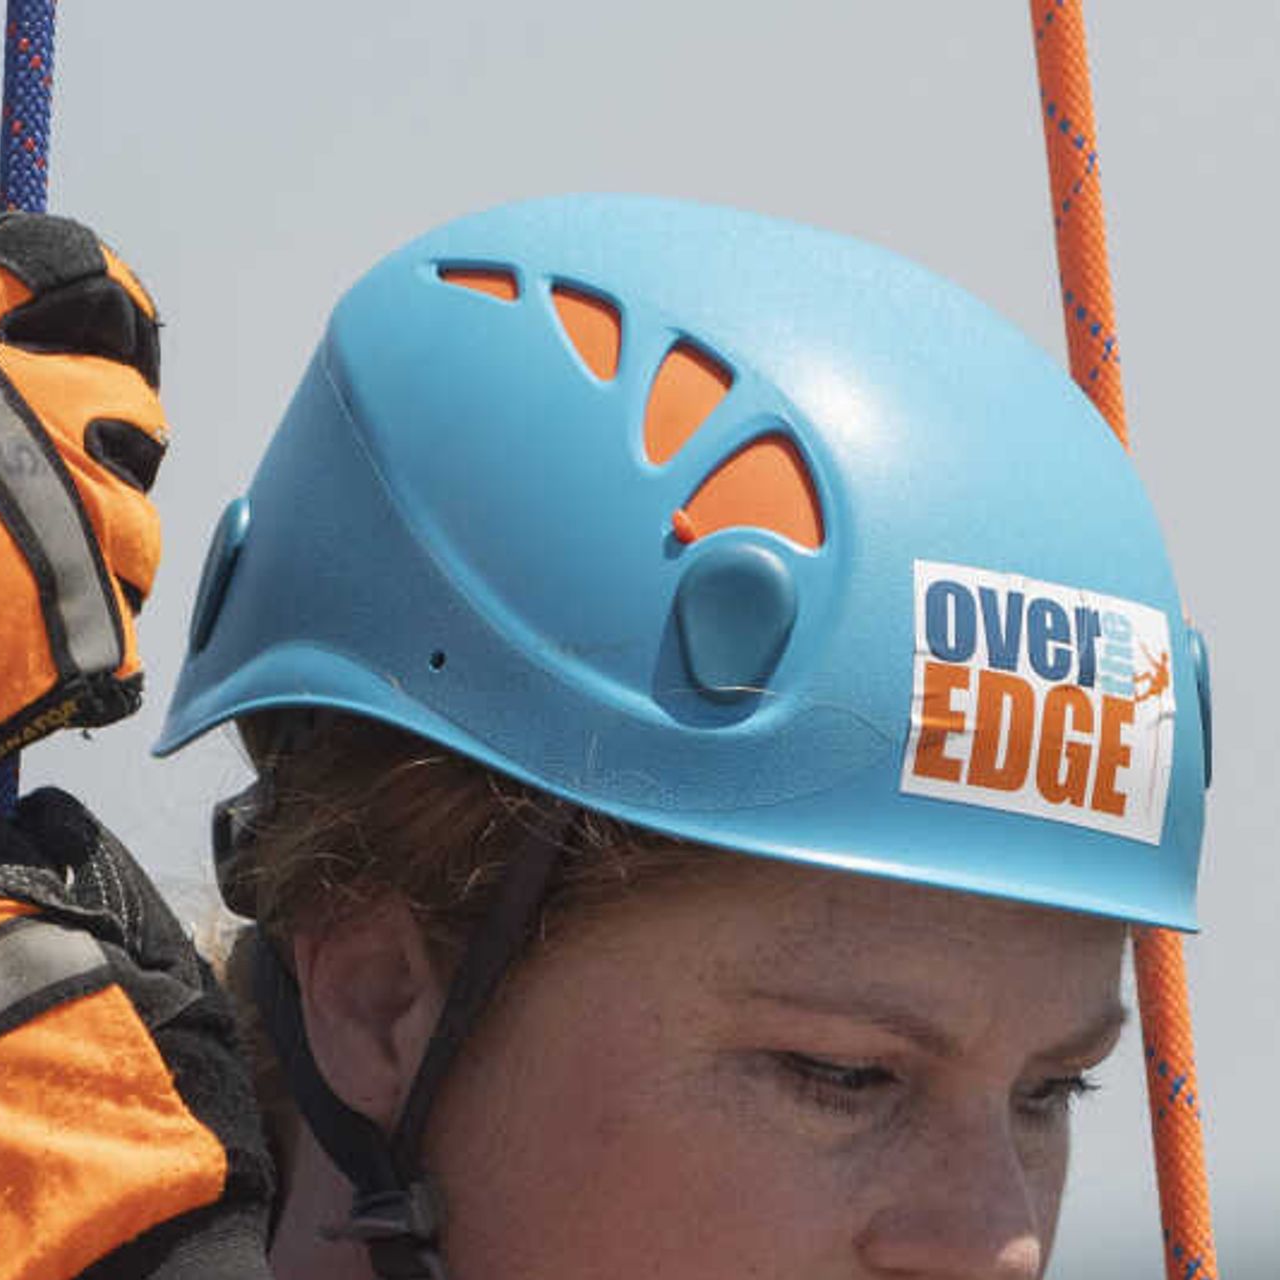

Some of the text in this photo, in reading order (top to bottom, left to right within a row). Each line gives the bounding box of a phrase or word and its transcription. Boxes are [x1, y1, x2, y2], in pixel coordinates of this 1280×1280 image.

[925, 579, 1102, 688] over
[1100, 611, 1135, 697] the
[912, 661, 1136, 818] EDGE
